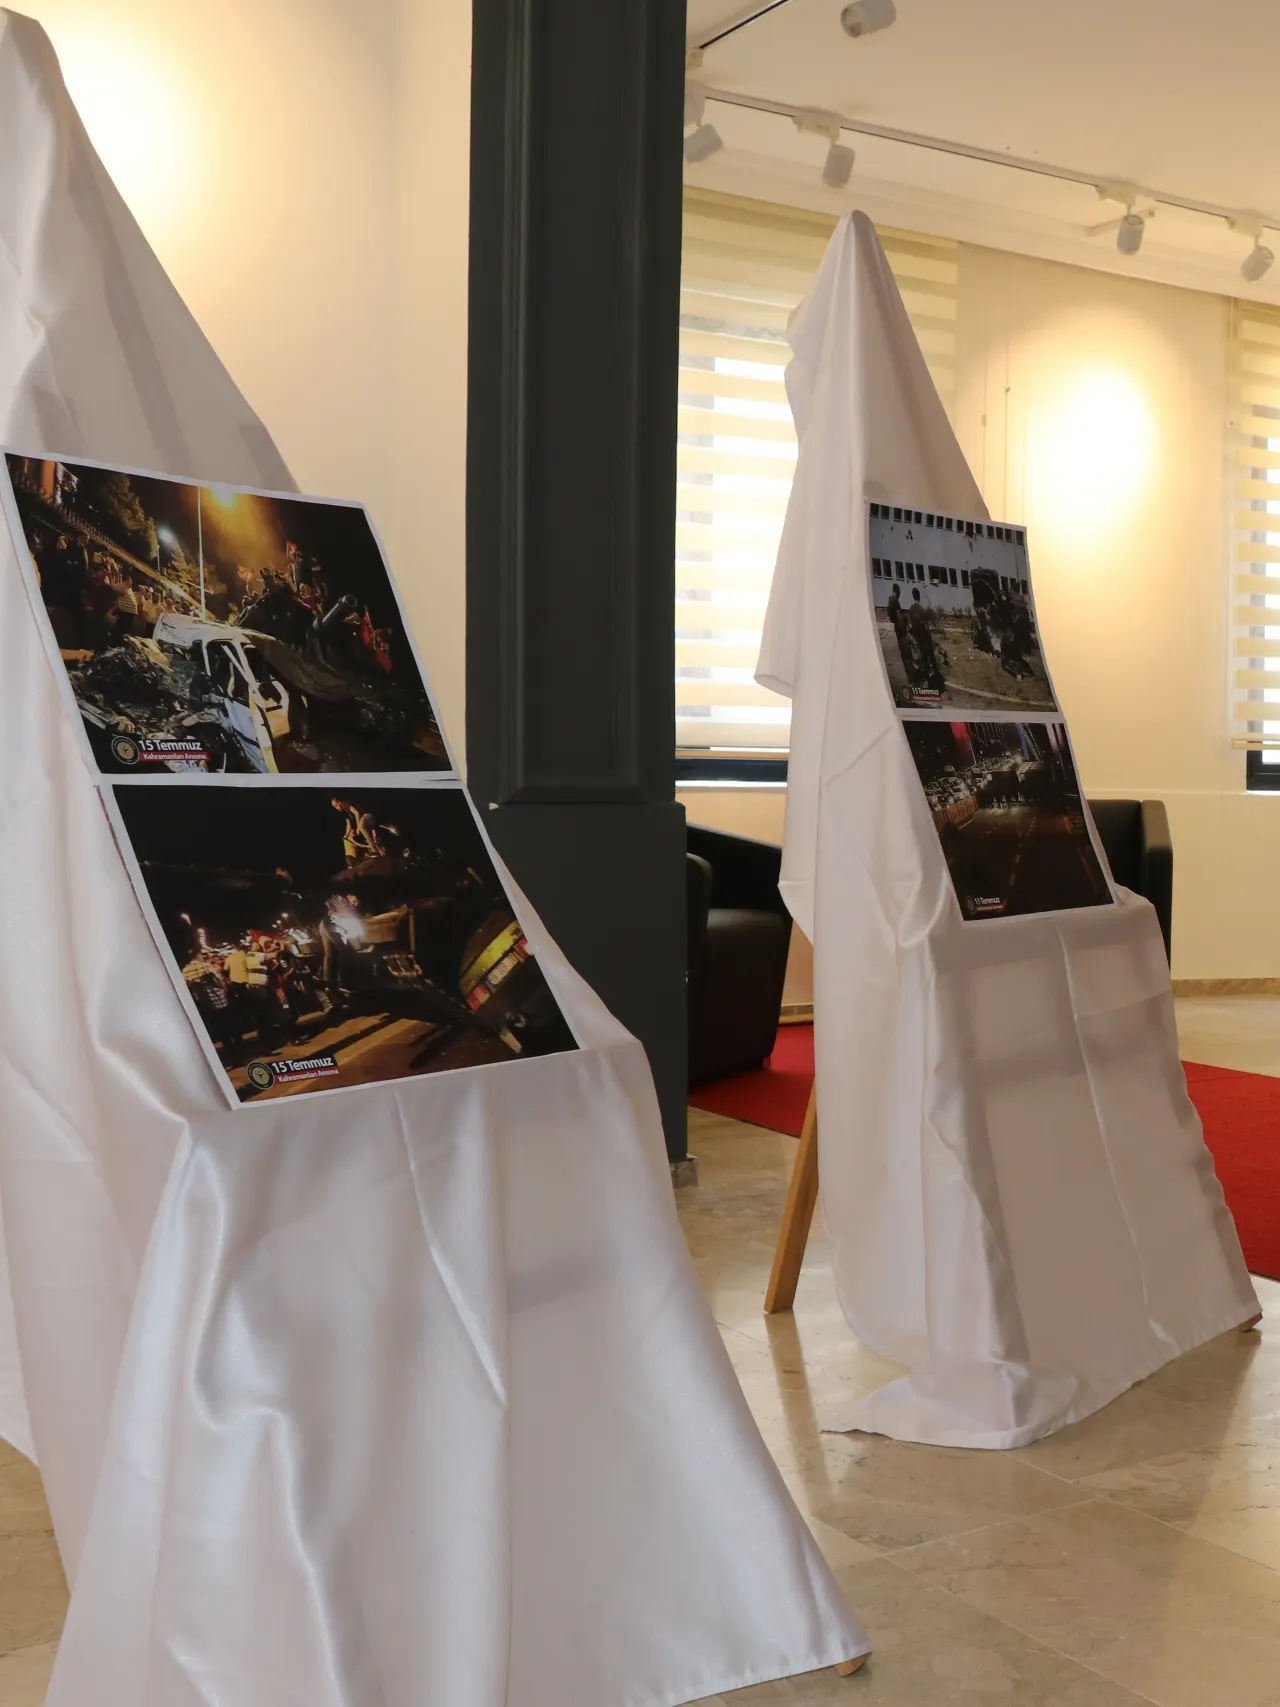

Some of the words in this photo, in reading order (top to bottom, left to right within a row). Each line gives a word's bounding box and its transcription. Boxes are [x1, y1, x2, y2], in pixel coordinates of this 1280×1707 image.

[138, 740, 153, 750] 15
[154, 740, 202, 750] Temmuz
[272, 1062, 287, 1073] 15
[287, 1057, 334, 1072] Temmuz
